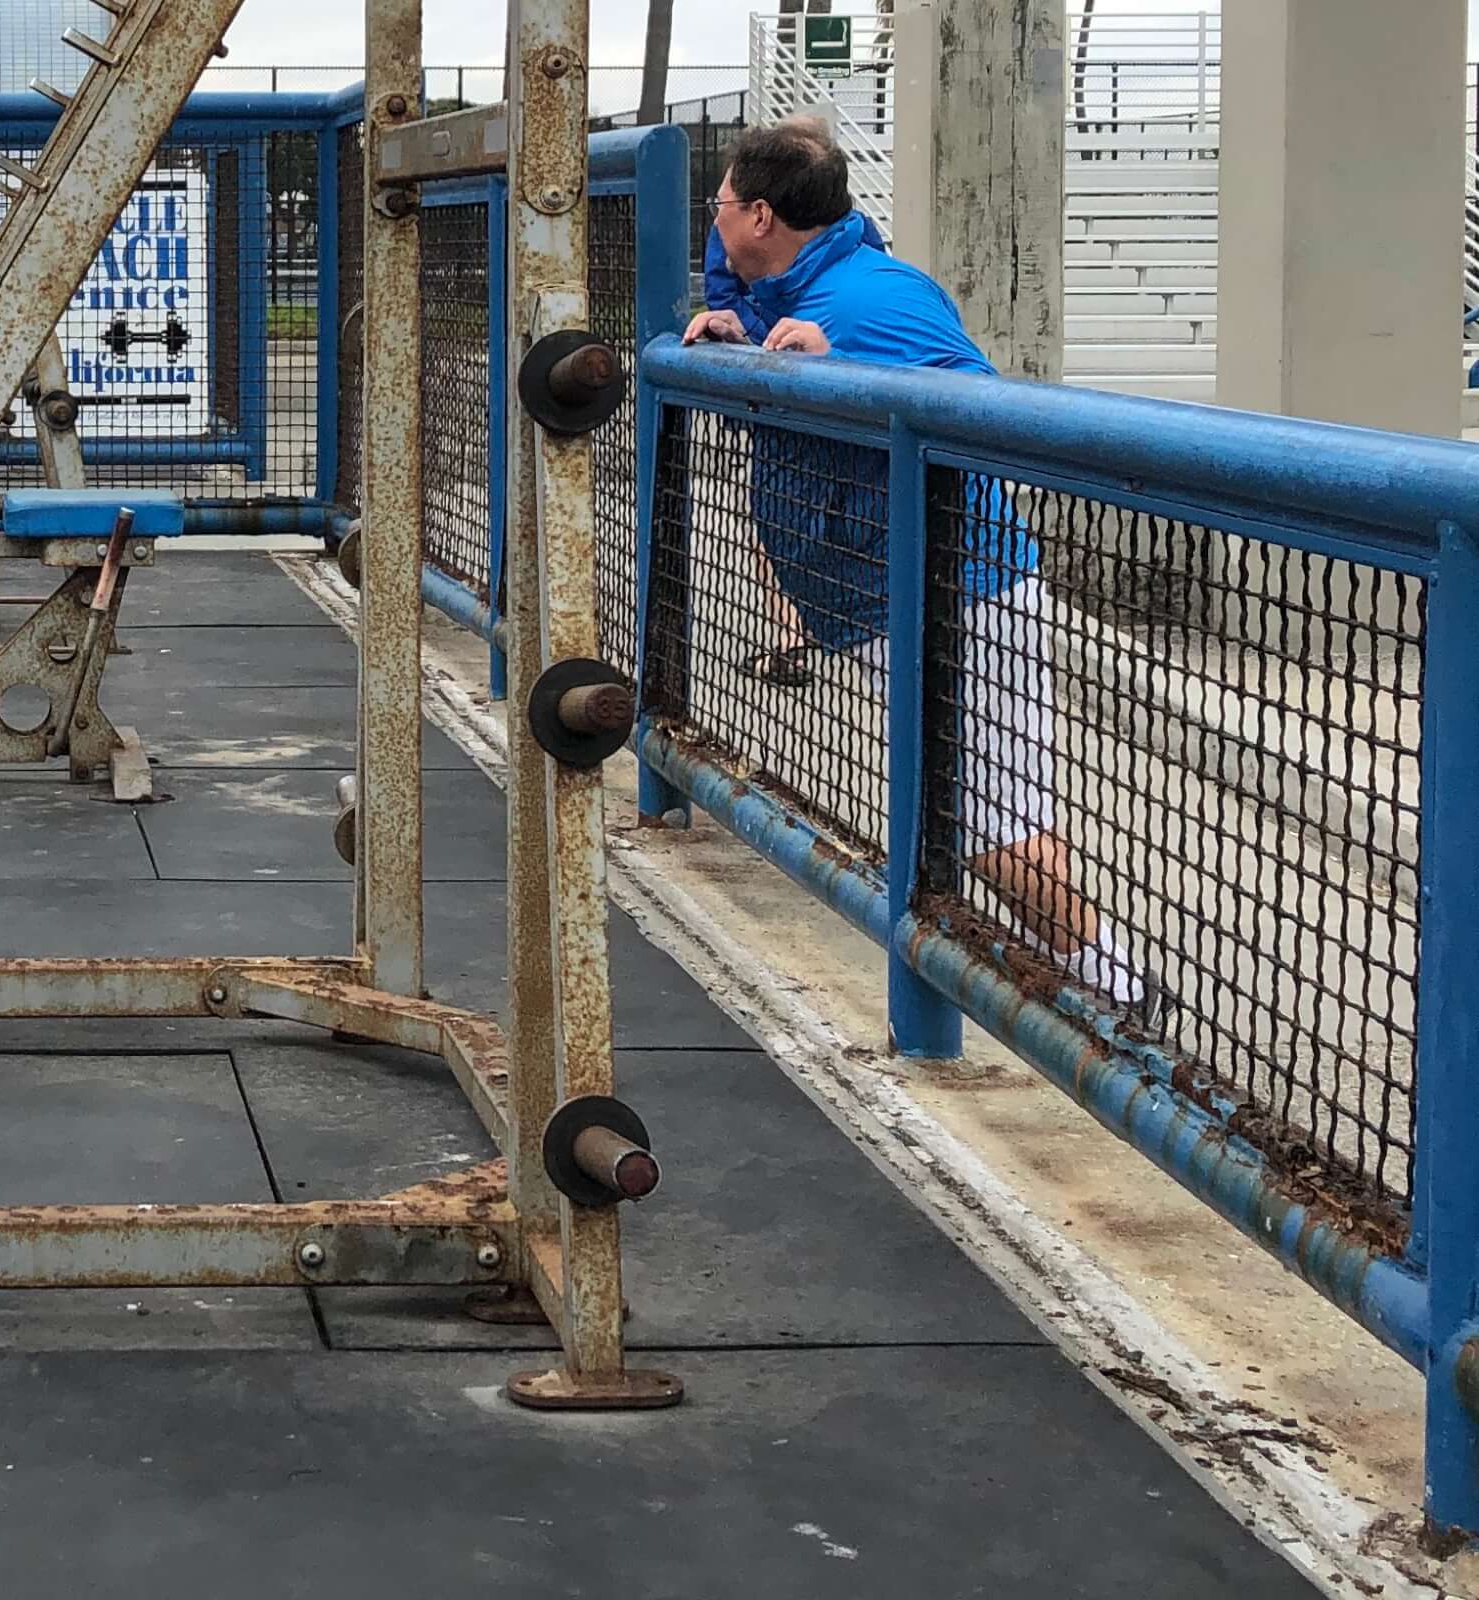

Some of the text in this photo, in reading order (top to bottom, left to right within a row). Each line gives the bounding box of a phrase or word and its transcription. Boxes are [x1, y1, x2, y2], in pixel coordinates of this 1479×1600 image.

[112, 195, 188, 232] CLE
[87, 234, 191, 280] ACH
[67, 285, 189, 310] enice
[71, 348, 196, 392] lifornia
